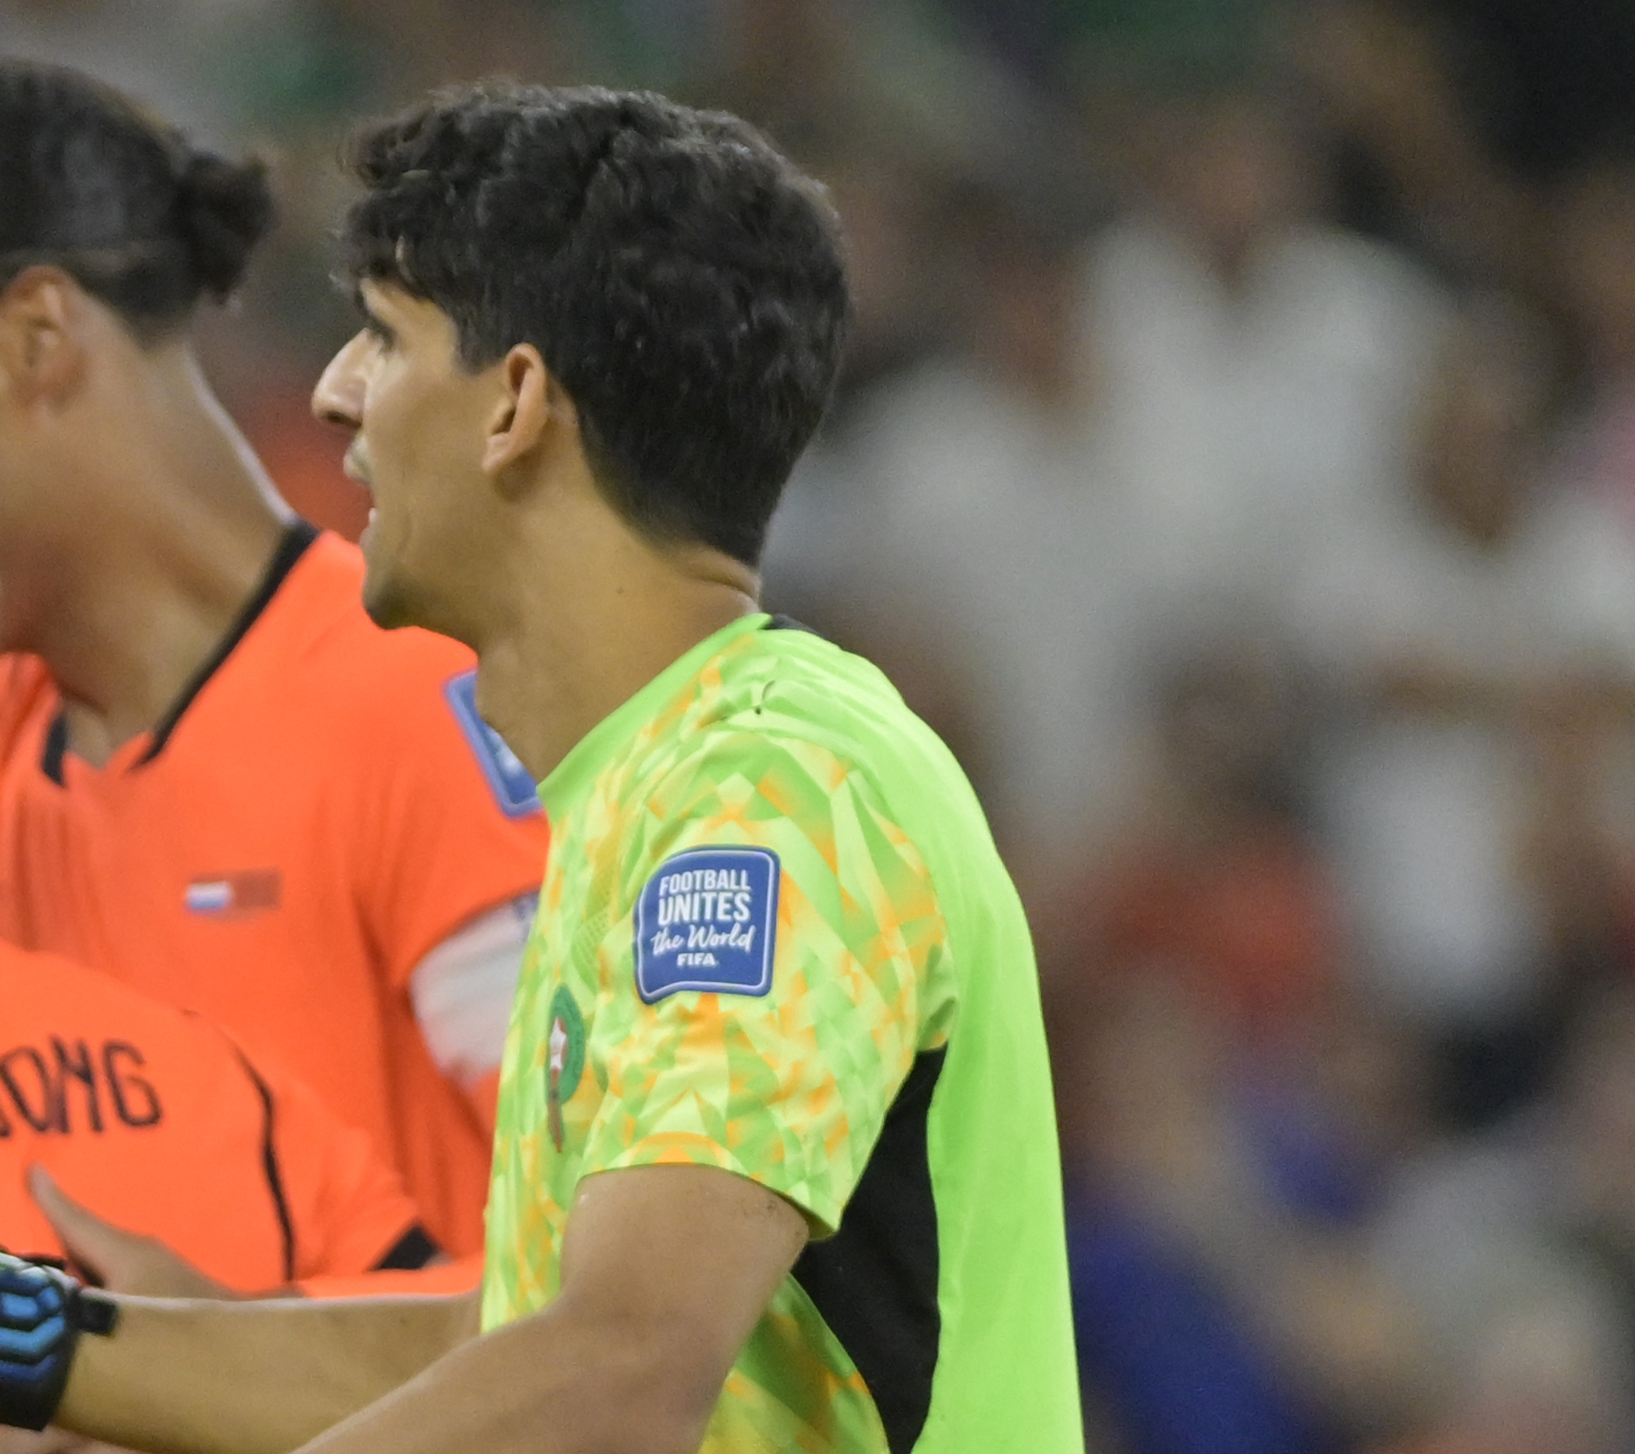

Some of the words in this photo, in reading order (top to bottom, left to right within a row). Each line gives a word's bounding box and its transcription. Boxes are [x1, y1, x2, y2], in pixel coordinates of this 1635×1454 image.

[659, 869, 752, 897] FOOTBALL
[658, 891, 752, 926] UNITES
[650, 927, 684, 956] the
[686, 922, 756, 953] World
[677, 952, 717, 967] FIFA
